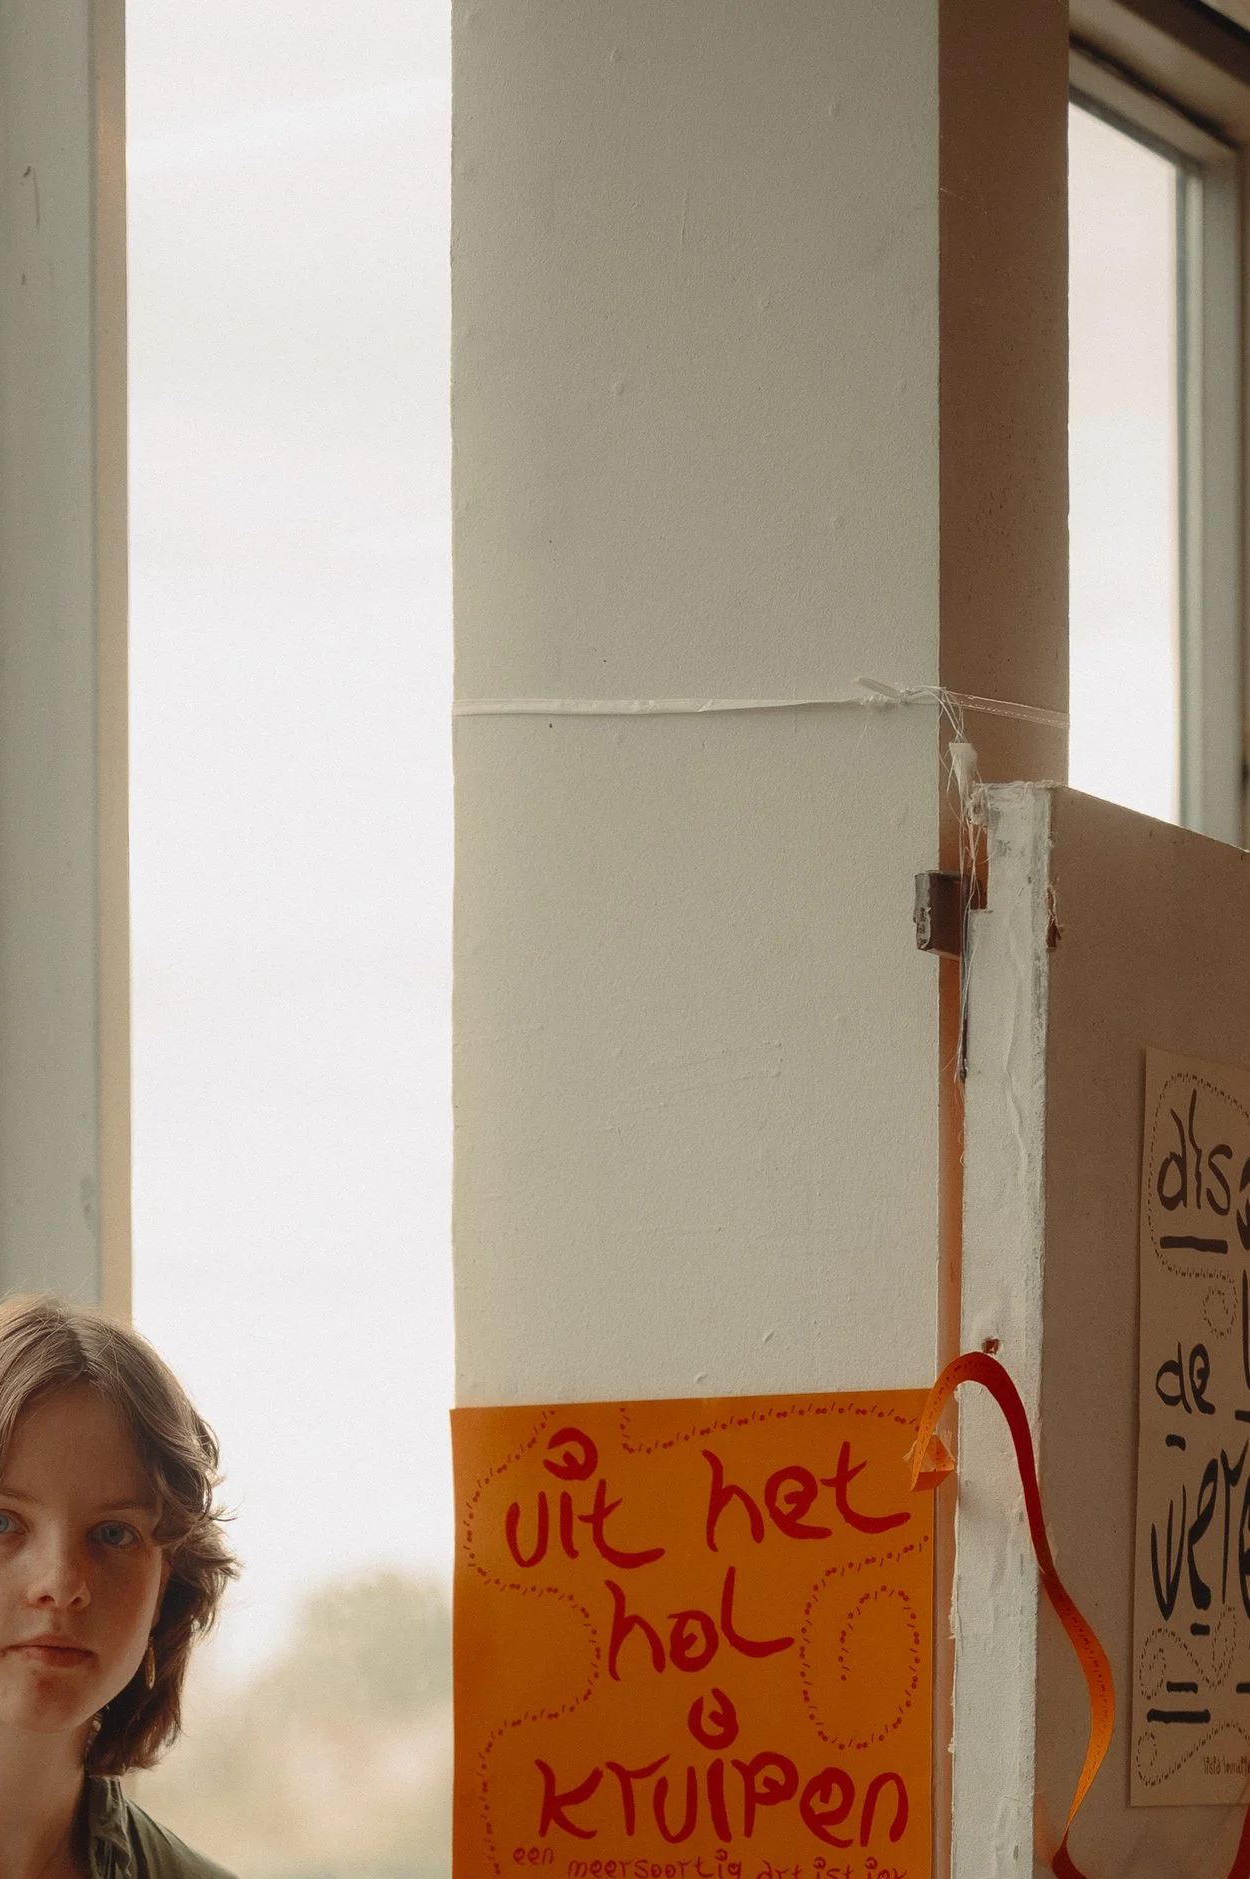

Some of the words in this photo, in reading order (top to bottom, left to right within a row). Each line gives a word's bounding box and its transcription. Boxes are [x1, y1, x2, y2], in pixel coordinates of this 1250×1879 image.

[505, 1426, 666, 1569] uit
[701, 1440, 912, 1553] het
[604, 1565, 795, 1682] hol
[513, 1846, 554, 1866] een
